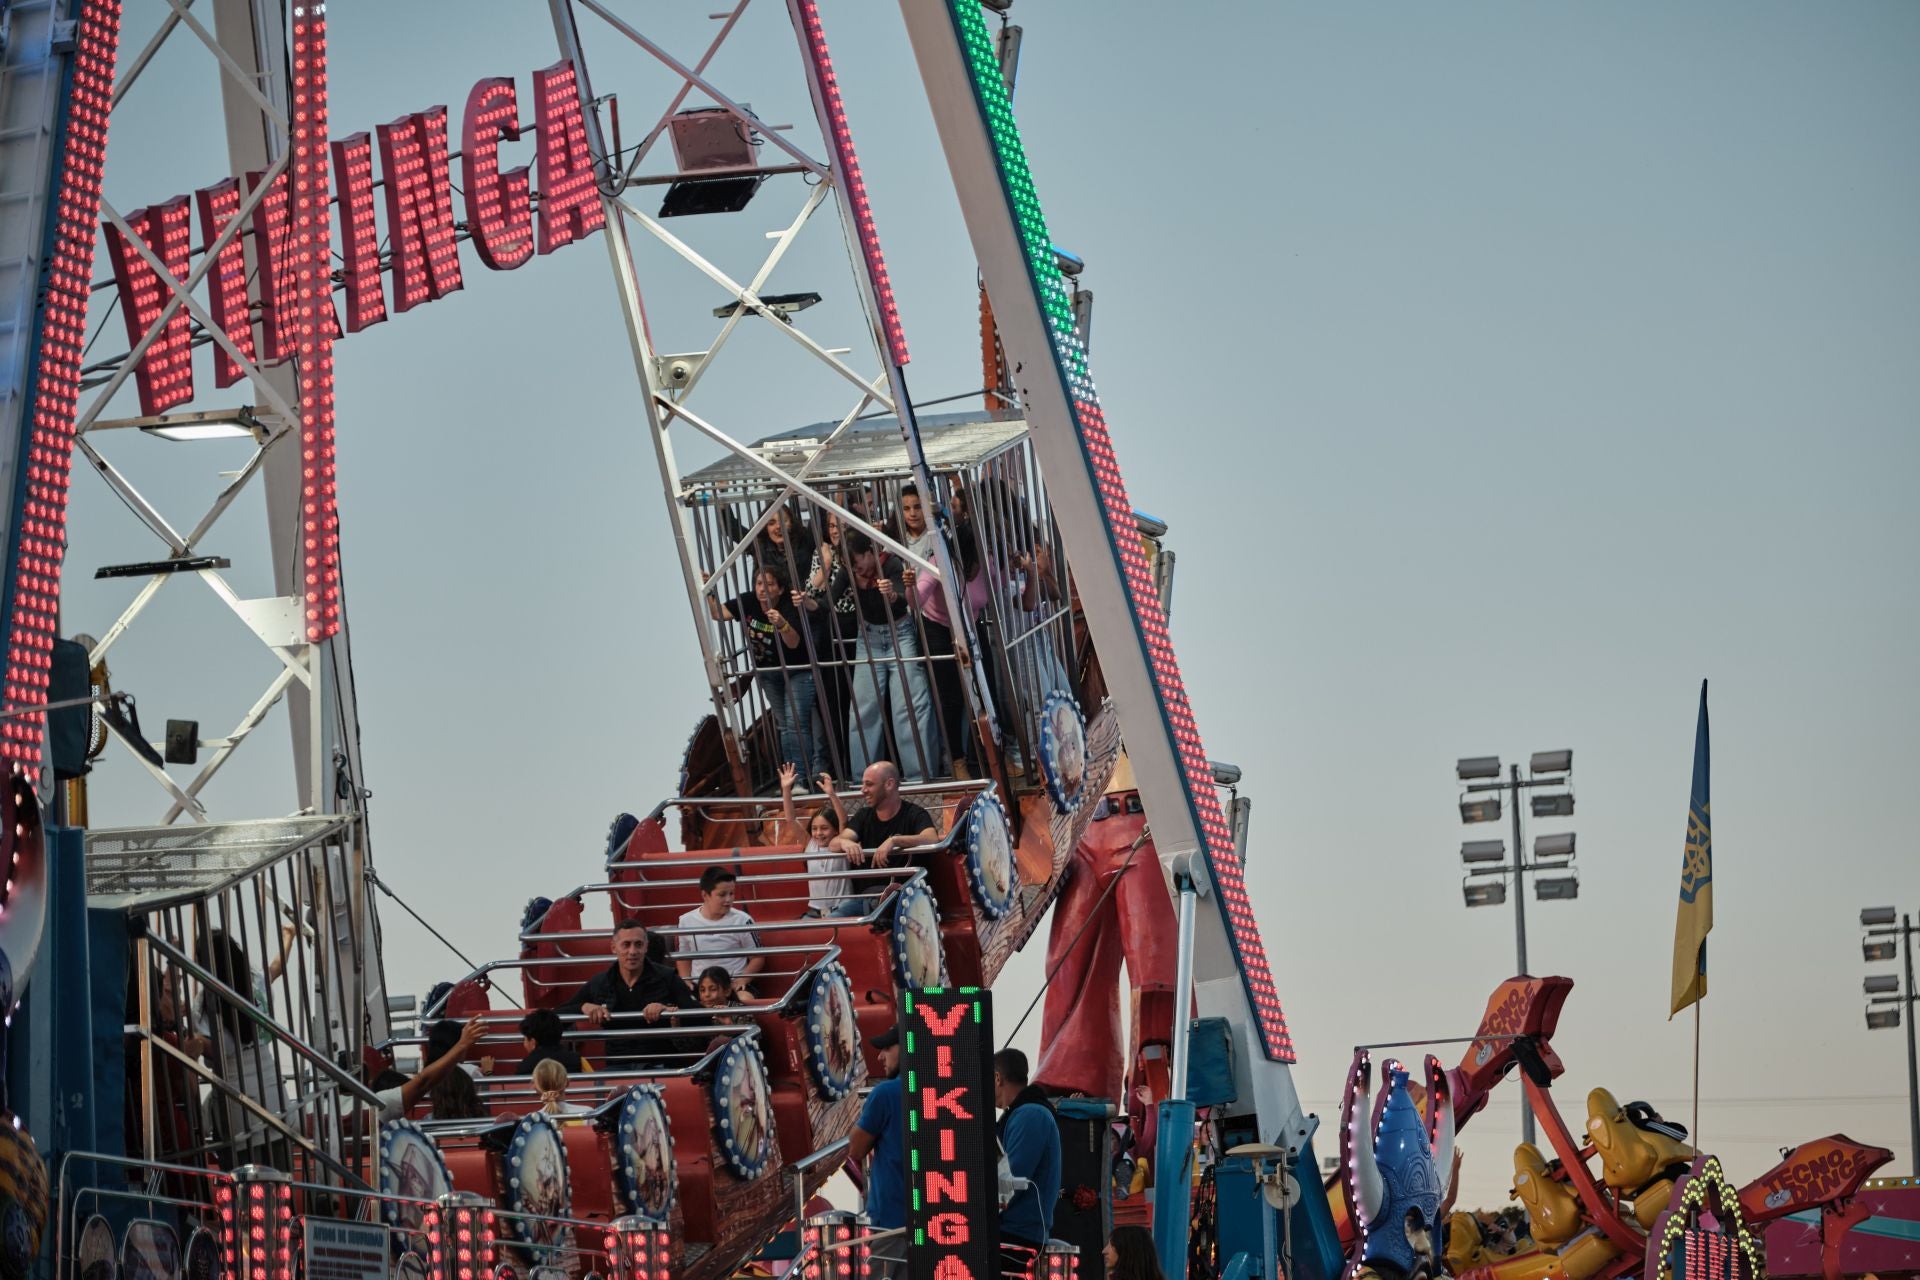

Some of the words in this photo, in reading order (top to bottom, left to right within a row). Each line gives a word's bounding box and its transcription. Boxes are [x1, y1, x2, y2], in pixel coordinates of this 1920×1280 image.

[1472, 988, 1520, 1048] TECNO
[915, 1003, 975, 1280] VIKINGA
[1761, 1149, 1844, 1194] TECNO
[1792, 1150, 1866, 1204] DANCE
